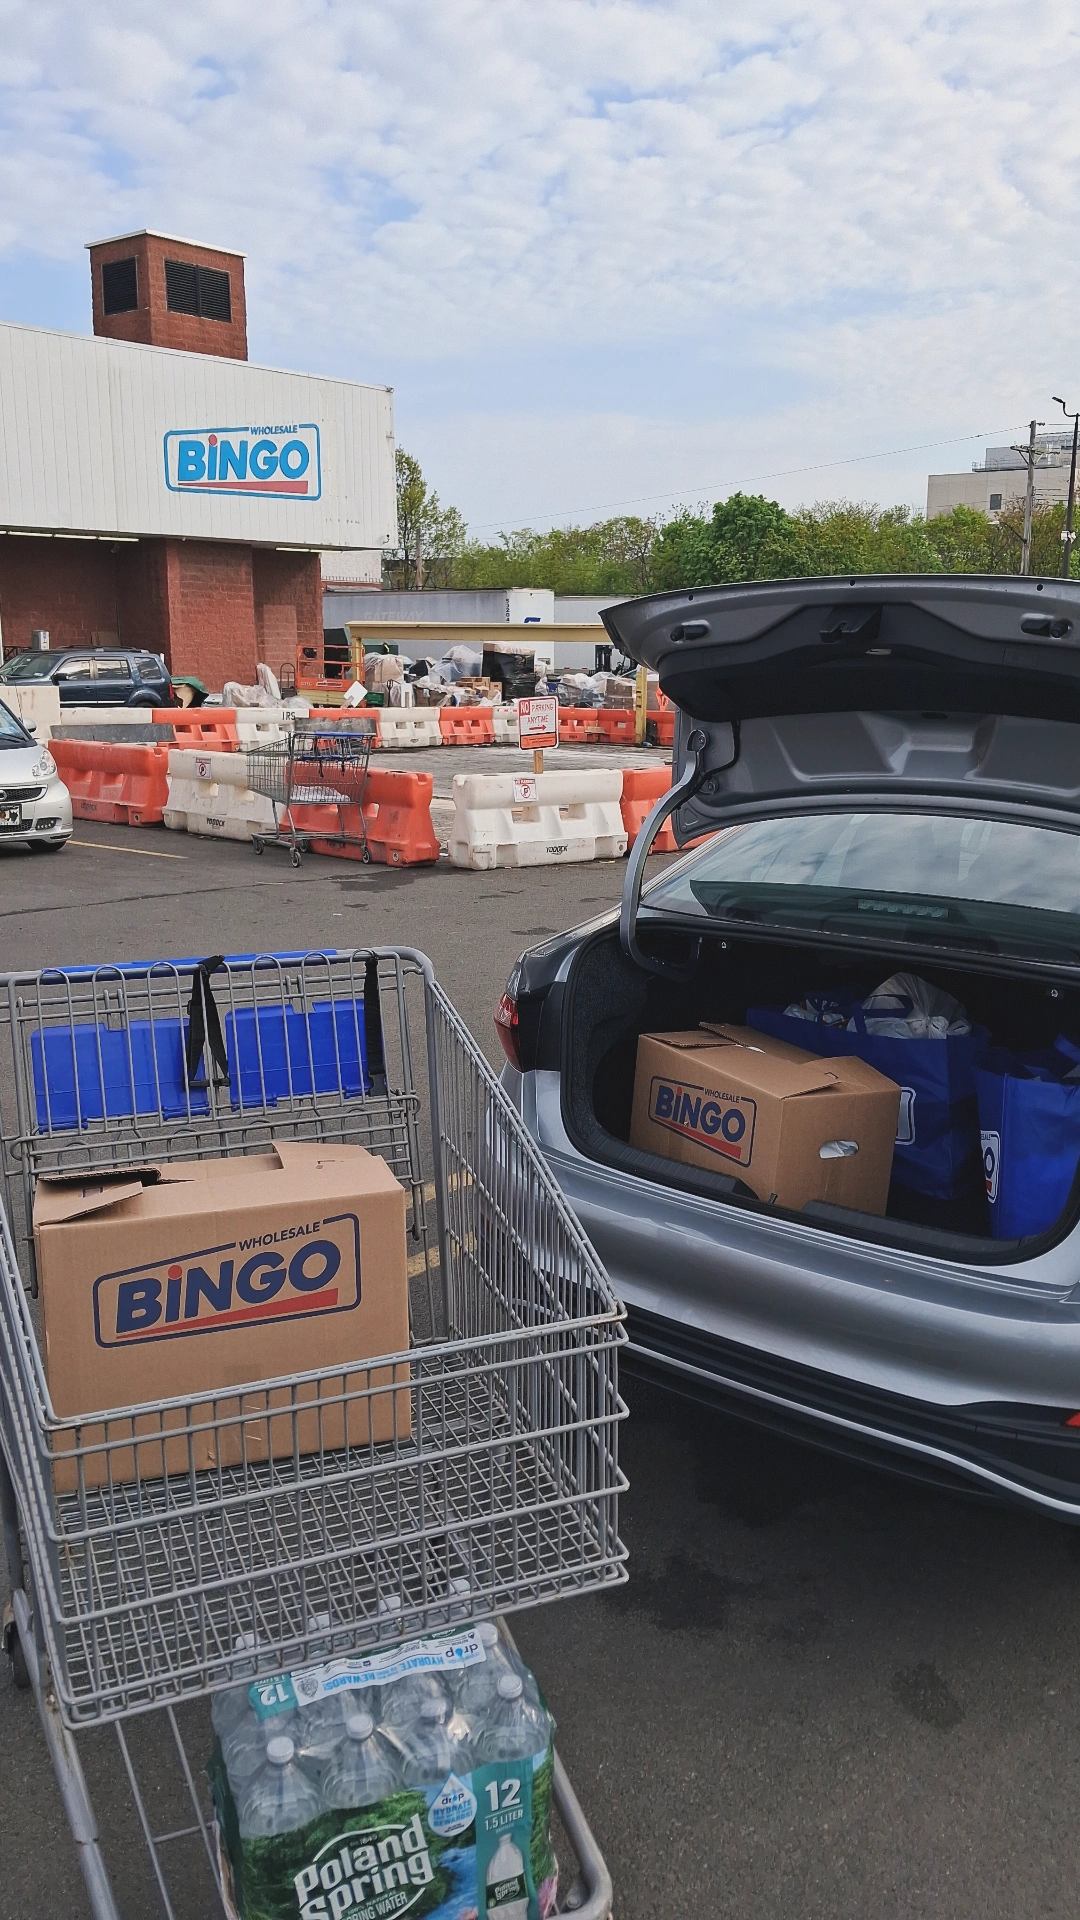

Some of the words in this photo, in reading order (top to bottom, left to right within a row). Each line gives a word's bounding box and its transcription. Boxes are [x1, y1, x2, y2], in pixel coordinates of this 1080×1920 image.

[250, 425, 298, 435] WHOLESALE
[363, 611, 424, 621] GATEWAY
[521, 701, 529, 714] NO
[531, 703, 554, 711] PARKING
[527, 715, 549, 724] ANYTIME
[704, 1088, 740, 1103] WHOLESALE
[239, 1221, 321, 1251] WHOLESALE
[400, 1656, 444, 1671] HYDRATE
[322, 1672, 376, 1692] REWARDS!
[257, 1684, 290, 1706] 12
[485, 1779, 521, 1812] 12
[433, 1799, 472, 1817] HYDRATE
[485, 1817, 499, 1831] 1.5
[500, 1809, 524, 1826] LITER
[293, 1813, 428, 1909] Poland
[375, 1891, 408, 1916] WATER
